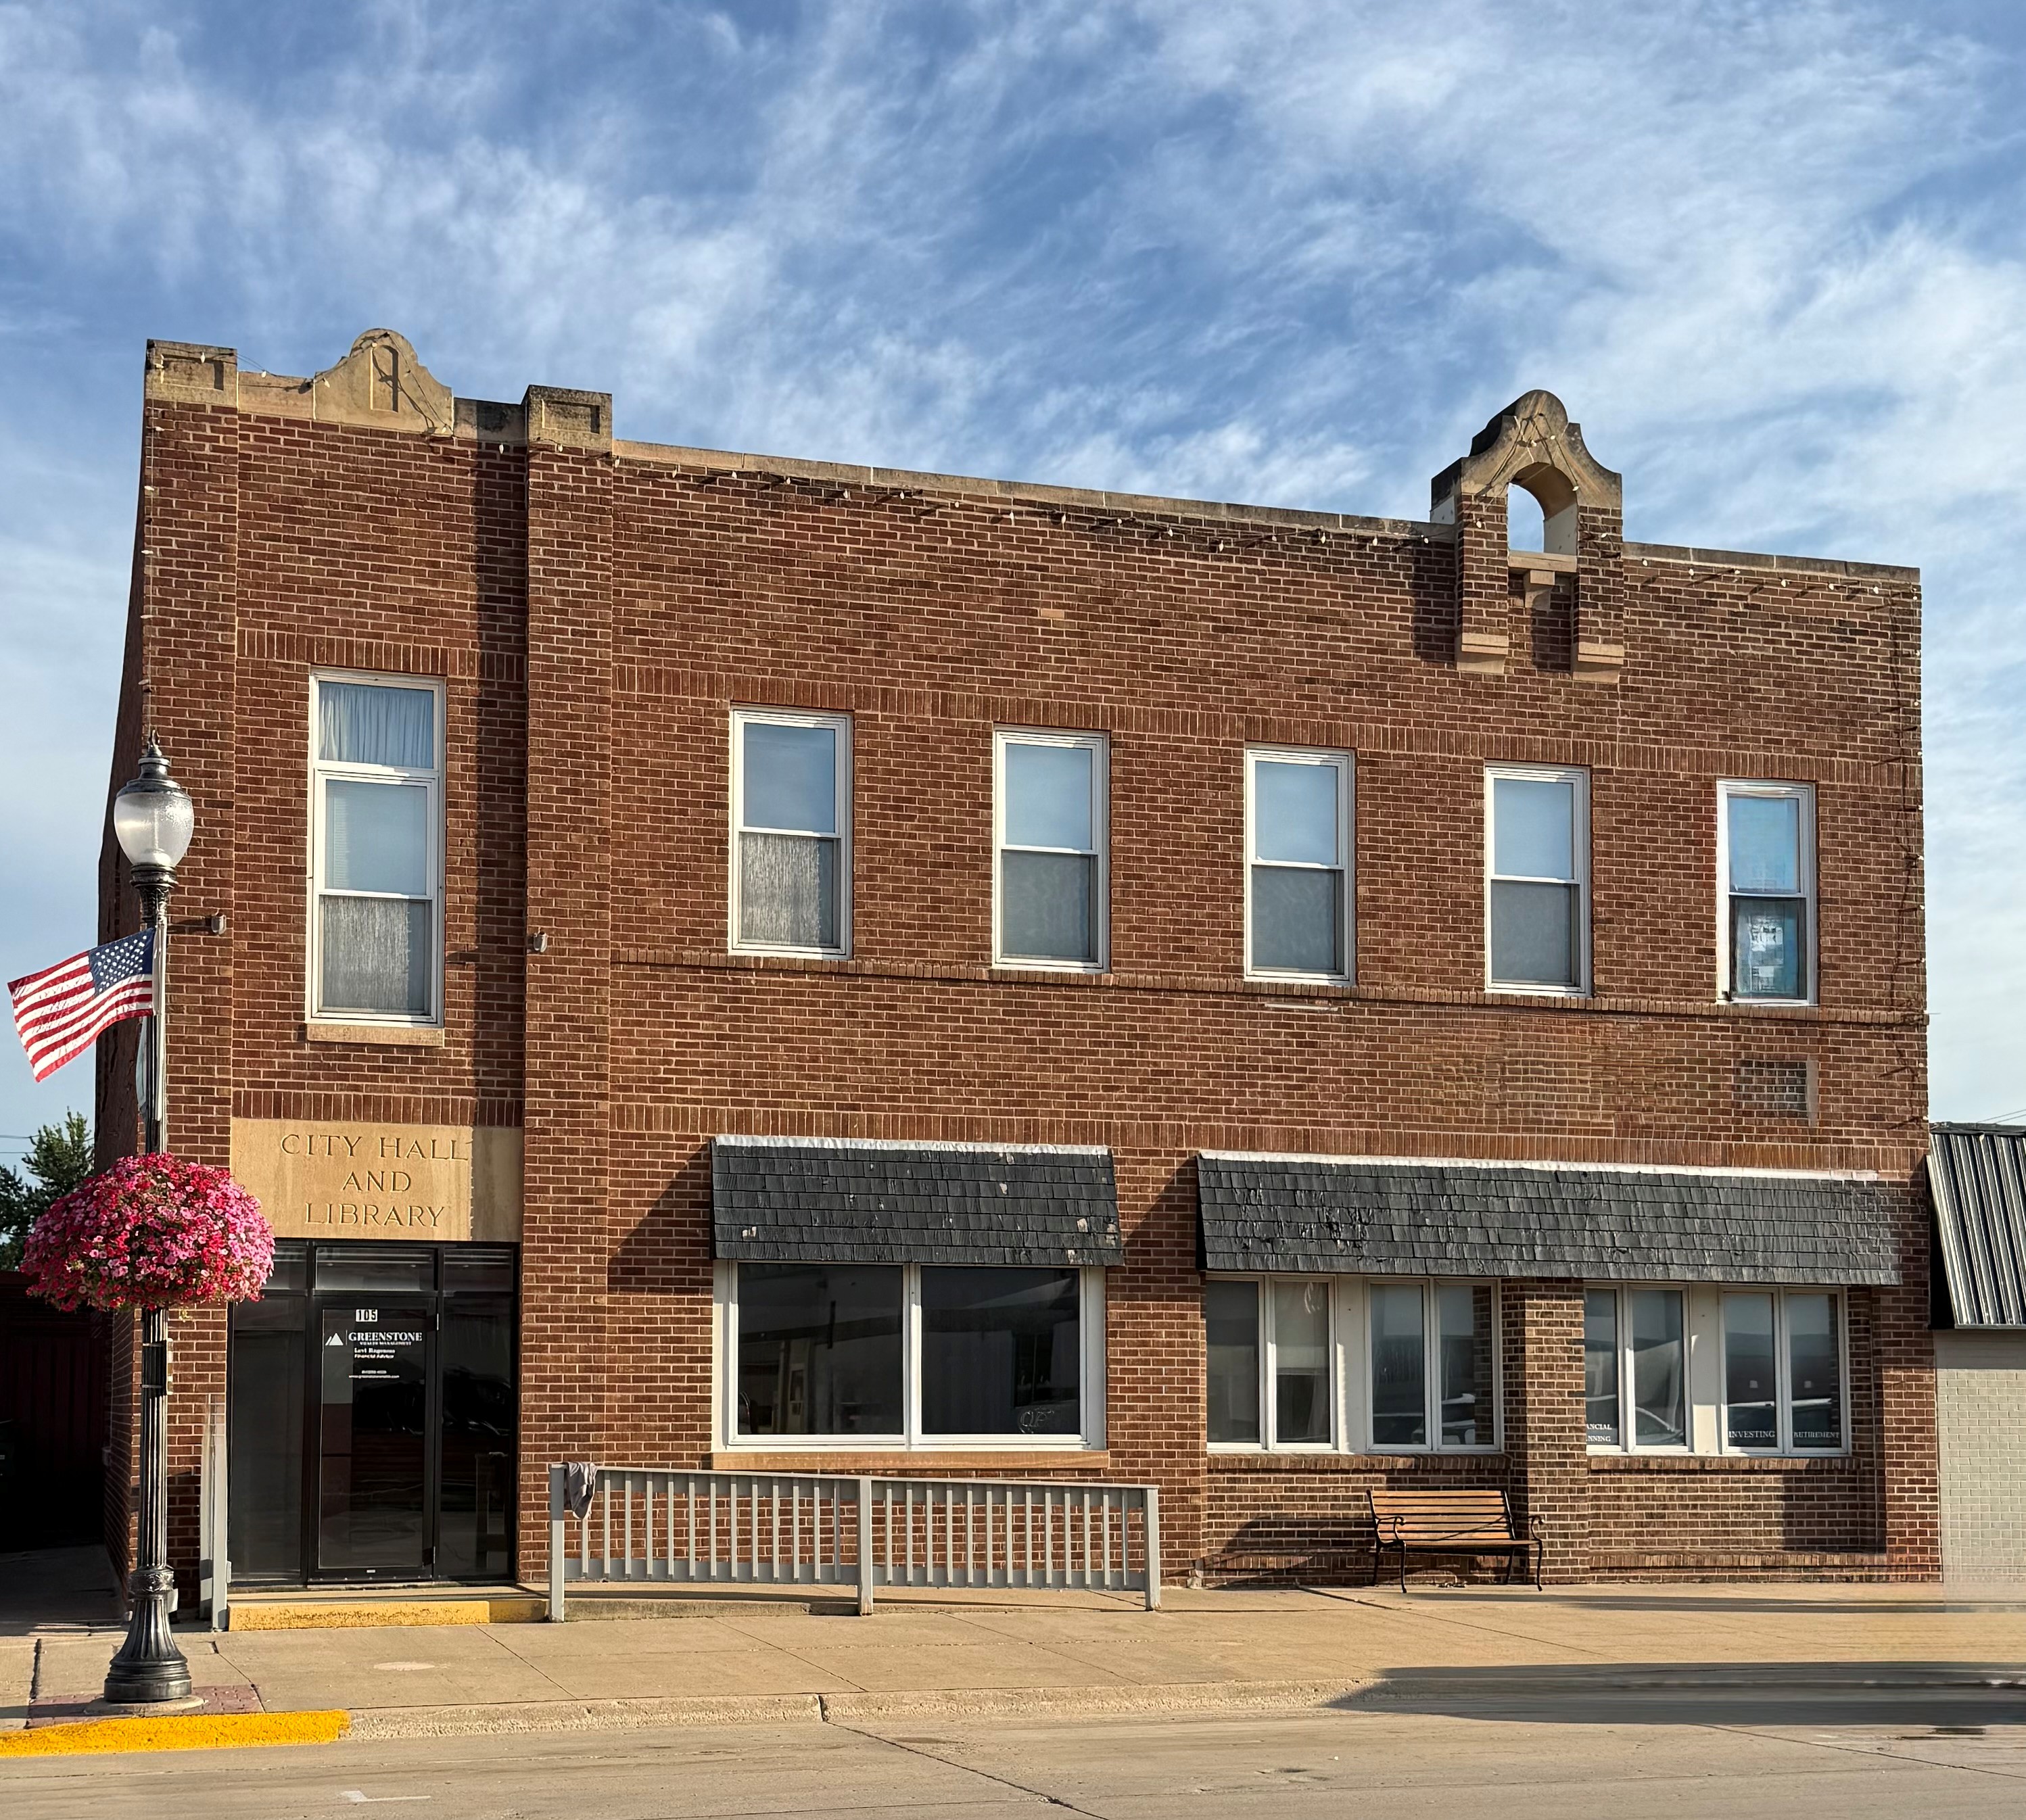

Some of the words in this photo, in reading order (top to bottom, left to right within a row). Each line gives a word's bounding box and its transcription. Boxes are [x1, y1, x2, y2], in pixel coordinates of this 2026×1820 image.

[281, 1133, 363, 1157] CITY
[379, 1136, 469, 1161] HALL
[342, 1170, 412, 1193] AND
[304, 1202, 445, 1228] LIBRARY
[358, 1310, 377, 1320] 105
[348, 1332, 423, 1341] GREENSTONE
